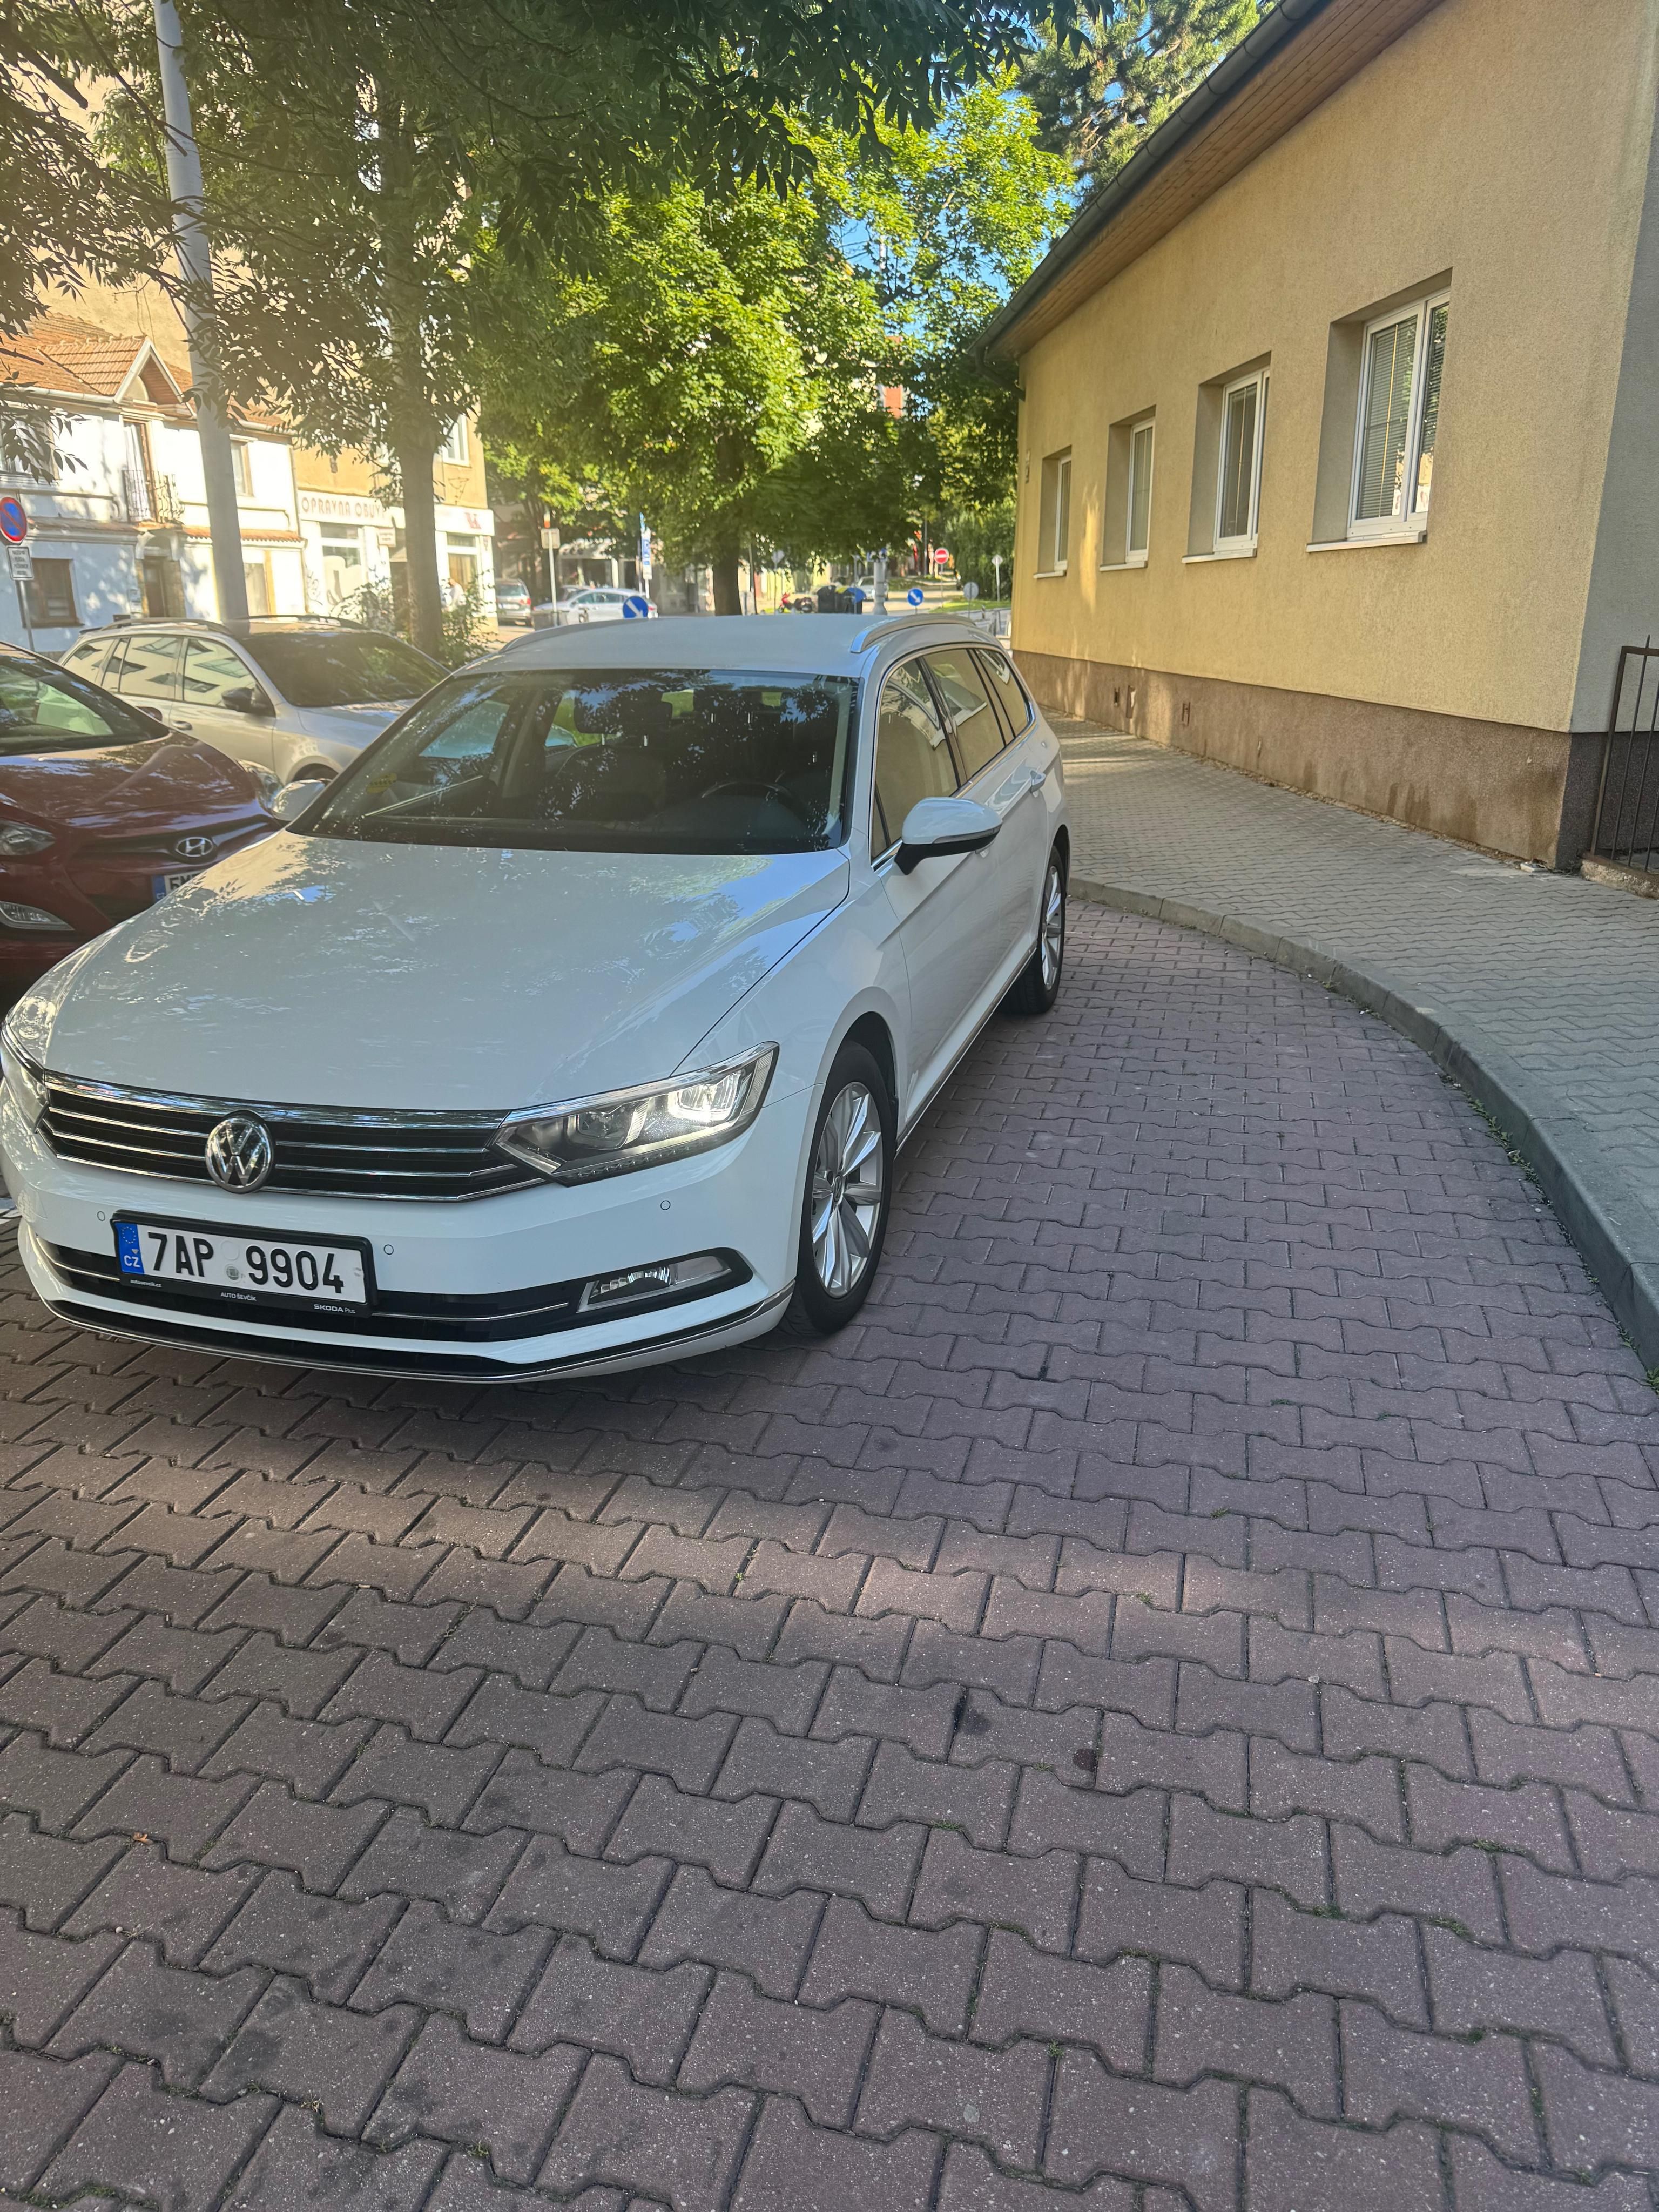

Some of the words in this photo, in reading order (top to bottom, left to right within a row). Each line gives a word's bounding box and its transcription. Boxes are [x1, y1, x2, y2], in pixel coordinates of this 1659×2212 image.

[301, 496, 350, 516] OPRAVNA
[124, 1255, 141, 1268] CZ
[147, 1231, 214, 1277] 7AP
[246, 1245, 345, 1294] 9904
